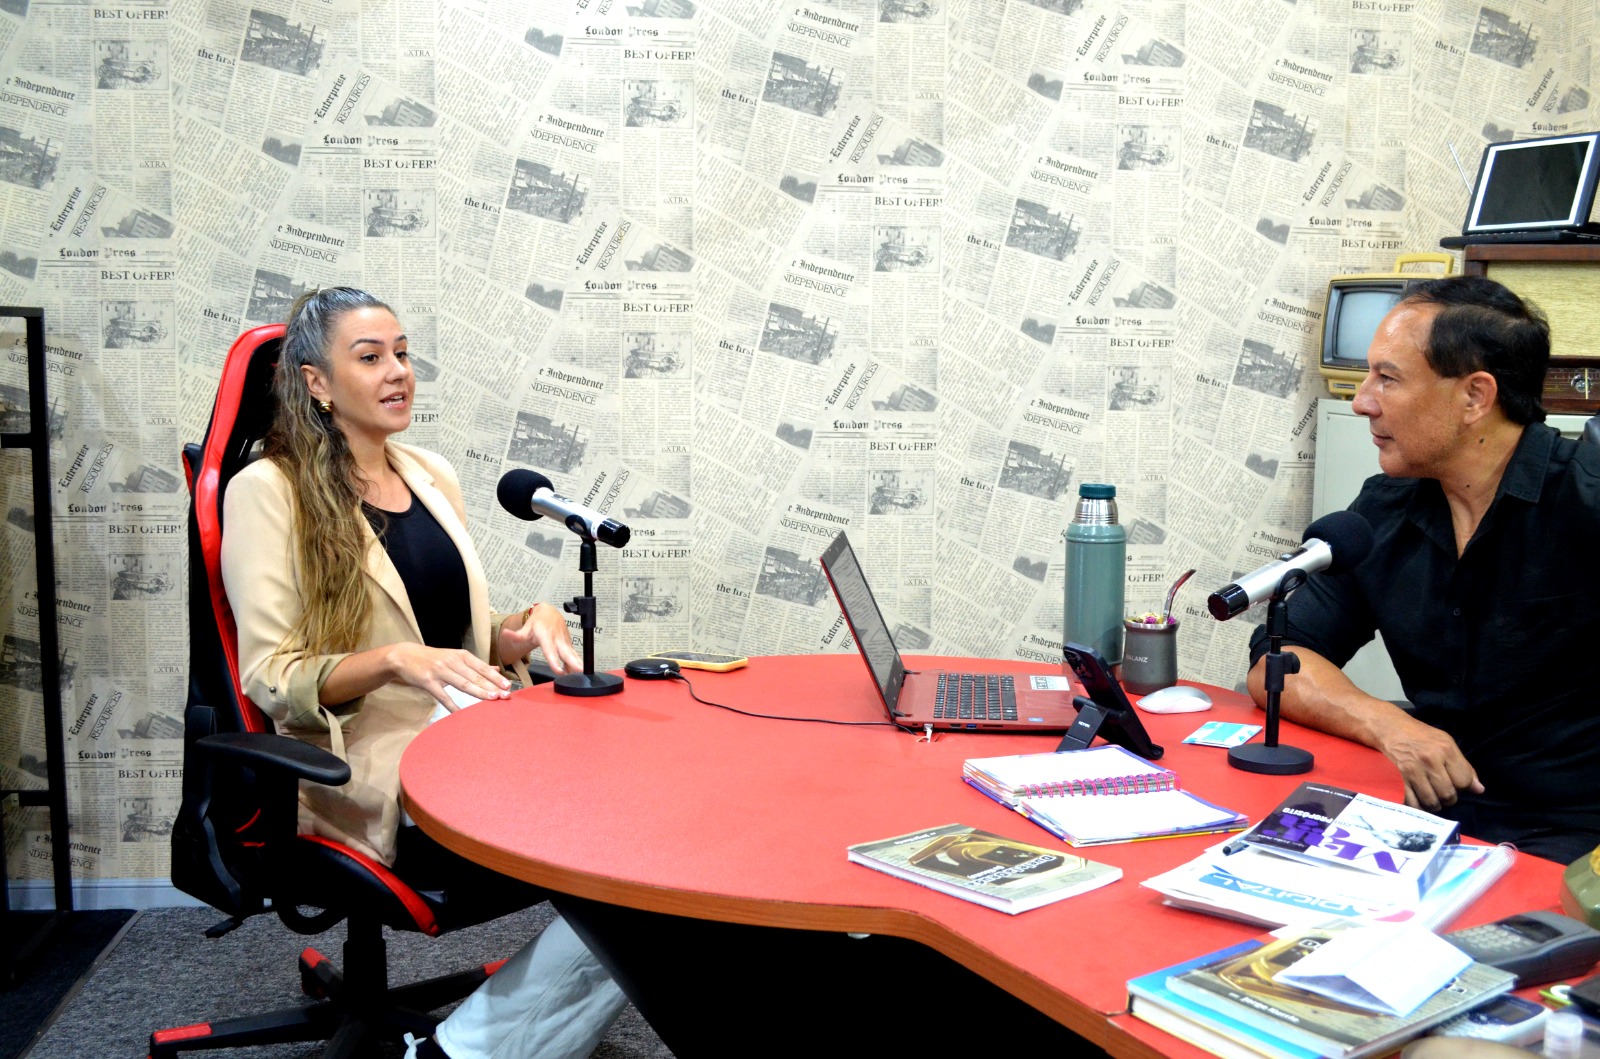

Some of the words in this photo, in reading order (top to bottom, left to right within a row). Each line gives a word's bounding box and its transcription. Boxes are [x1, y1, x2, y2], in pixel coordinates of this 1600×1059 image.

[1352, 2, 1376, 10] BEST
[94, 9, 122, 19] BEST
[803, 7, 859, 32] Independence
[585, 26, 623, 37] London
[1097, 16, 1129, 63] RESOURCES
[1435, 40, 1448, 50] the
[198, 48, 214, 59] the
[404, 49, 430, 57] XTRA
[624, 49, 652, 60] BEST
[1283, 58, 1333, 83] Independence
[1083, 72, 1118, 83] London
[15, 76, 76, 100] Independence
[336, 74, 371, 125] RESOURCES
[722, 89, 737, 99] the
[1118, 95, 1144, 105] BEST
[546, 115, 605, 138] Independence
[323, 135, 362, 146] London
[851, 115, 884, 165] RESOURCES
[1207, 135, 1221, 145] the
[139, 160, 166, 168] XTRA
[364, 159, 392, 169] BEST
[1045, 155, 1099, 180] Independence
[837, 174, 875, 185] London
[1322, 161, 1353, 208] RESOURCES
[464, 197, 480, 208] the
[875, 197, 901, 207] BEST
[73, 185, 107, 238] RESOURCES
[1309, 217, 1342, 228] London
[286, 224, 345, 248] Independence
[967, 235, 983, 245] the
[598, 220, 632, 271] RESOURCES
[1341, 238, 1366, 248] BEST
[59, 247, 99, 259] London
[101, 270, 129, 280] BEST
[799, 260, 855, 282] Independence
[584, 280, 622, 291] London
[1088, 258, 1121, 307] RESOURCES
[203, 307, 220, 318] the
[623, 303, 651, 313] BEST
[1272, 298, 1322, 320] Independence
[1075, 315, 1110, 326] London
[719, 340, 735, 350] the
[909, 338, 934, 346] XTRA
[1110, 338, 1135, 348] BEST
[546, 367, 604, 390] Independence
[1197, 374, 1211, 383] the
[847, 362, 879, 411] RESOURCES
[1038, 399, 1090, 420] Independence
[146, 417, 173, 425] XTRA
[833, 420, 869, 431] London
[869, 442, 896, 451] BEST
[466, 450, 482, 460] the
[82, 443, 114, 493] RESOURCES
[960, 477, 976, 487] the
[68, 503, 106, 515] London
[795, 504, 850, 525] Independence
[109, 524, 137, 534] BEST
[622, 549, 649, 558] BEST
[717, 584, 731, 593] the
[1186, 606, 1200, 616] the
[91, 691, 122, 741] RESOURCES
[78, 750, 116, 761] London
[118, 769, 146, 779] BEST
